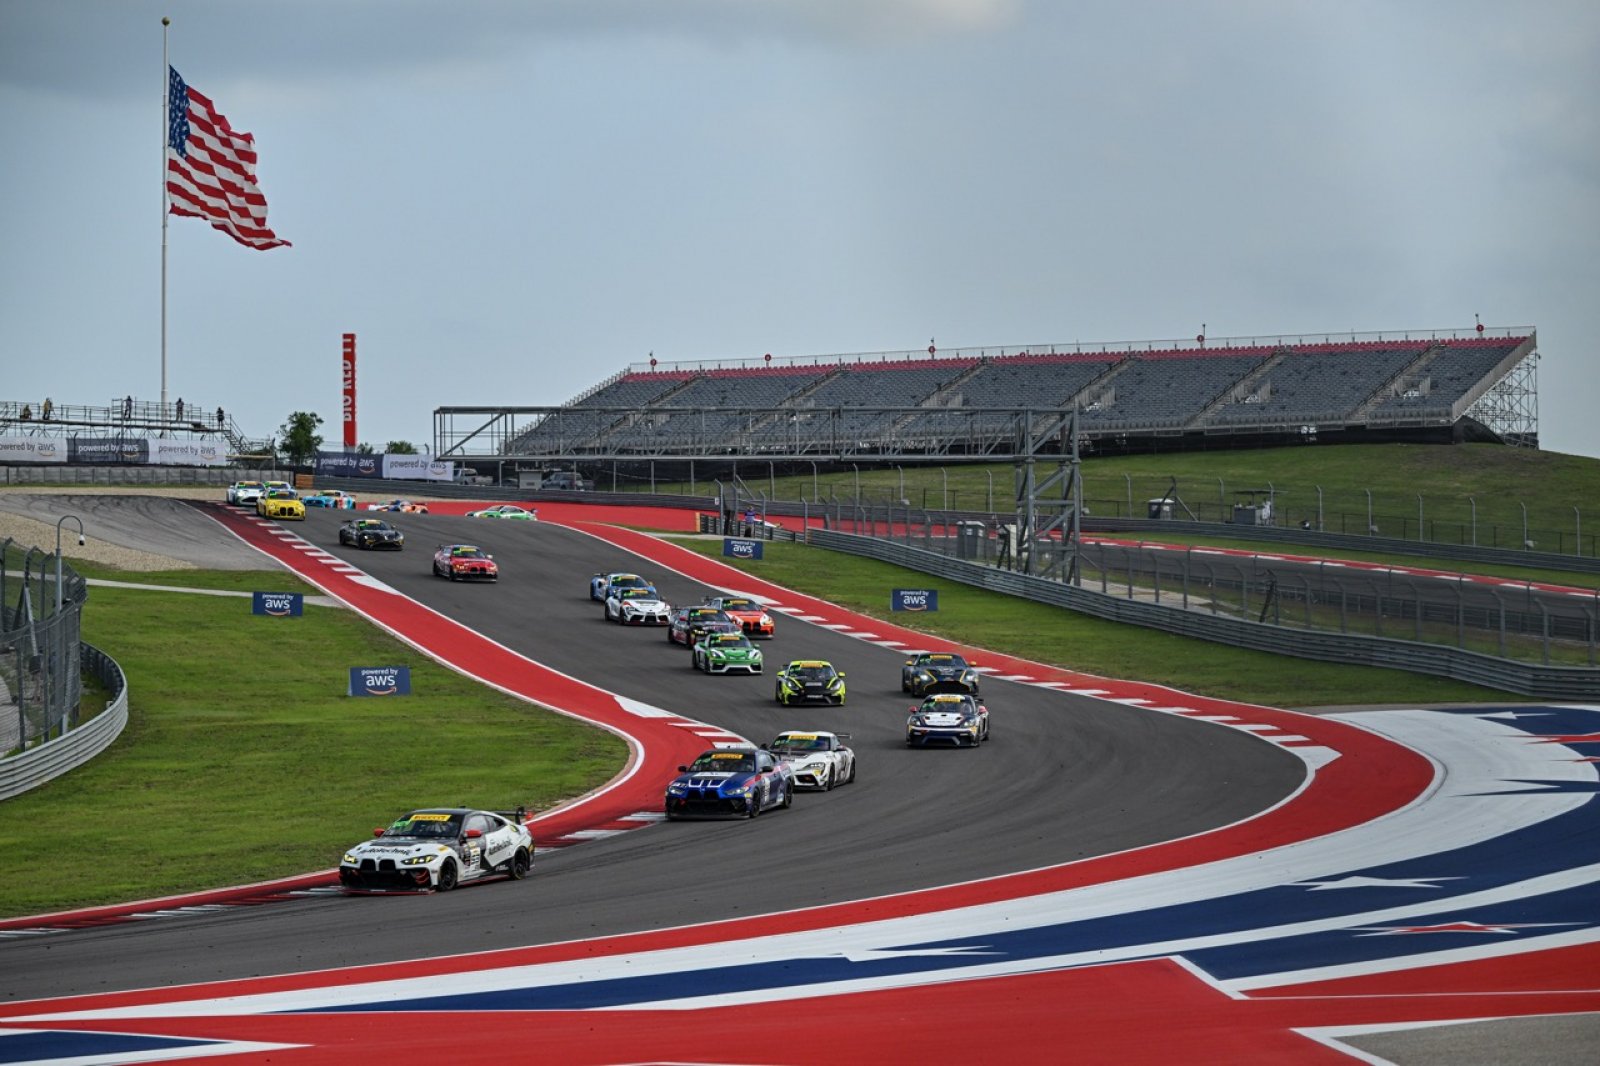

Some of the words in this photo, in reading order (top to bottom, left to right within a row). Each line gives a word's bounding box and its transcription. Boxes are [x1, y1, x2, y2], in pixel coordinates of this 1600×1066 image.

[0, 442, 25, 451] owered
[78, 443, 110, 454] powered
[110, 443, 120, 453] by
[158, 445, 188, 454] powered
[189, 445, 198, 455] by
[320, 457, 348, 467] powered
[348, 458, 357, 468] by
[358, 459, 375, 467] aws
[389, 460, 419, 470] powered
[420, 460, 428, 470] by
[732, 545, 754, 553] aws
[286, 593, 294, 601] by
[903, 596, 926, 604] aws
[265, 599, 291, 608] aws
[389, 668, 399, 676] by
[365, 675, 396, 686] aws
